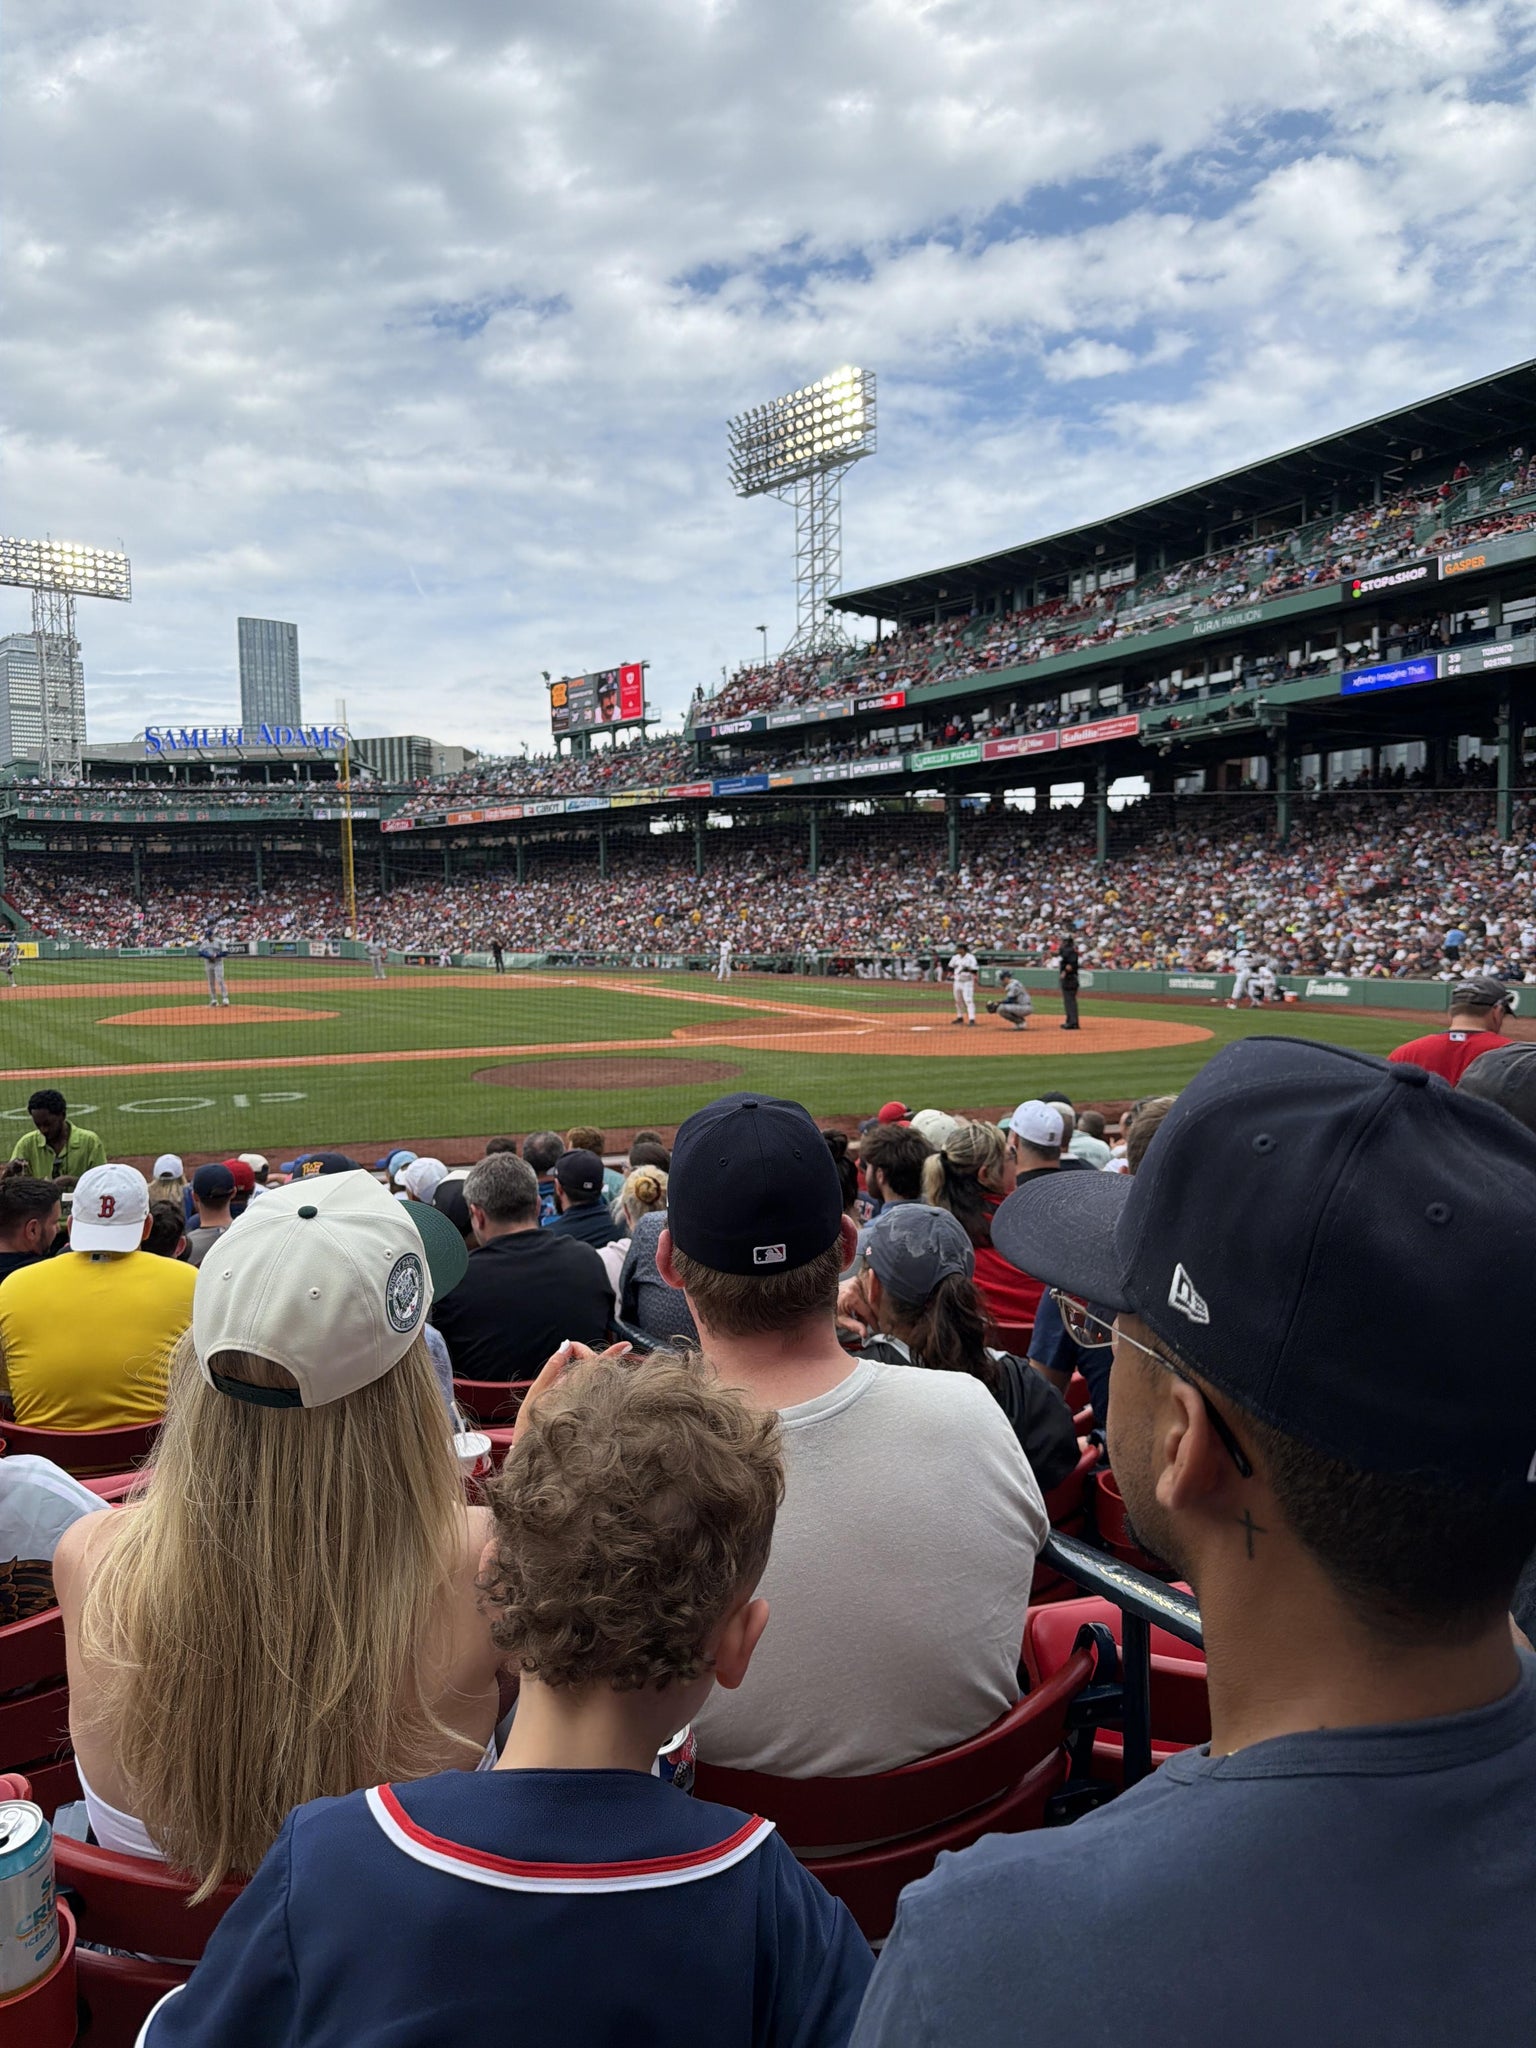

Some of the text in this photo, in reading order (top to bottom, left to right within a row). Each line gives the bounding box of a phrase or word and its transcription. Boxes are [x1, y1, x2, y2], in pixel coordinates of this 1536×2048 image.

[1445, 555, 1485, 575] GASPER
[145, 722, 348, 754] SAMUEL ADAMS
[97, 1195, 116, 1218] B
